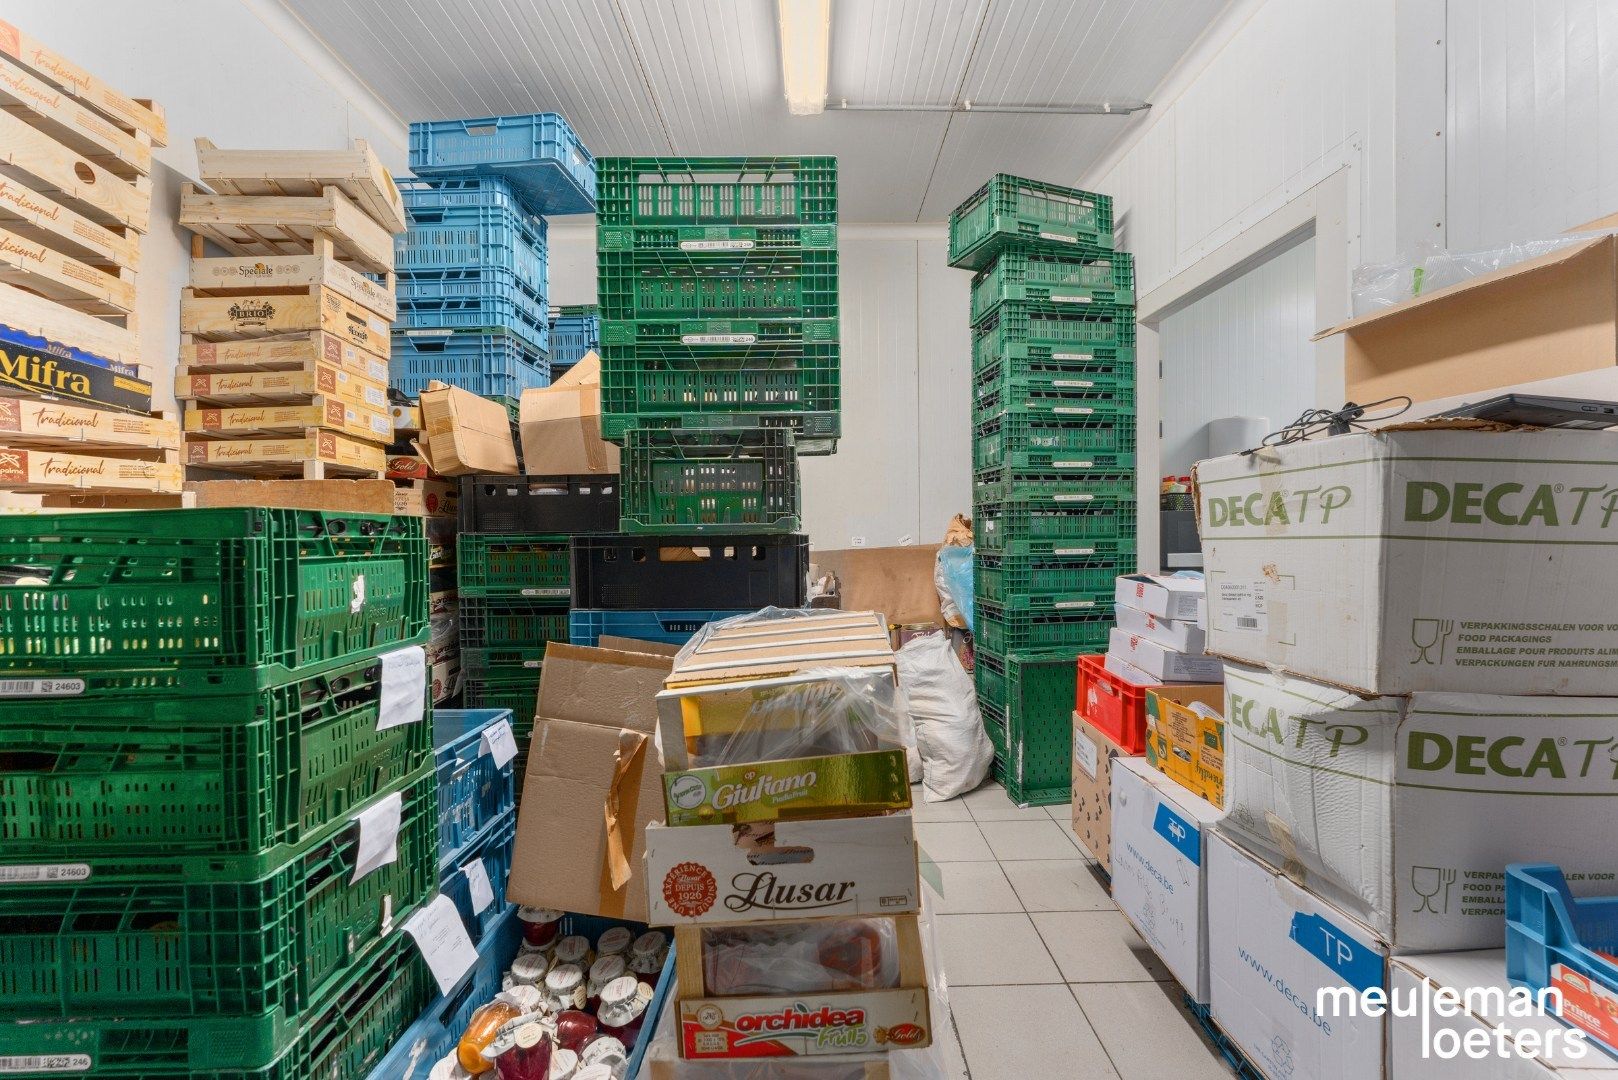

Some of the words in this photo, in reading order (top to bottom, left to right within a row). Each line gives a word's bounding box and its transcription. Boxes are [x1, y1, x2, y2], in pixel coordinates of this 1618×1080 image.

[238, 265, 273, 278] Speciale
[0, 350, 91, 396] Mifra
[110, 364, 136, 378] Mifra
[1460, 621, 1575, 632] VERPAKKINGSSCHALEN
[1578, 623, 1604, 631] VOOR
[1458, 634, 1486, 642] FOOD
[1489, 635, 1552, 643] PACKAGINGS
[1457, 646, 1516, 655] EMBALLAGE
[1519, 647, 1545, 655] POUR
[1548, 647, 1595, 656] PRODUITS
[1455, 658, 1535, 668] VERPACKUNGEN
[55, 682, 81, 691] 24603
[712, 771, 817, 810] Giuliano
[61, 867, 87, 876] 24603
[1126, 841, 1175, 895] www.deca.be
[1588, 873, 1615, 881] VOOR
[675, 883, 705, 891] DEPUIS
[724, 872, 855, 912] Llusar
[1463, 884, 1491, 892] FOOD
[679, 891, 702, 901] 1926
[1318, 924, 1353, 966] TP
[1238, 945, 1333, 1037] www.deca.be
[736, 1006, 866, 1033] orchidea
[72, 1058, 88, 1066] 246
